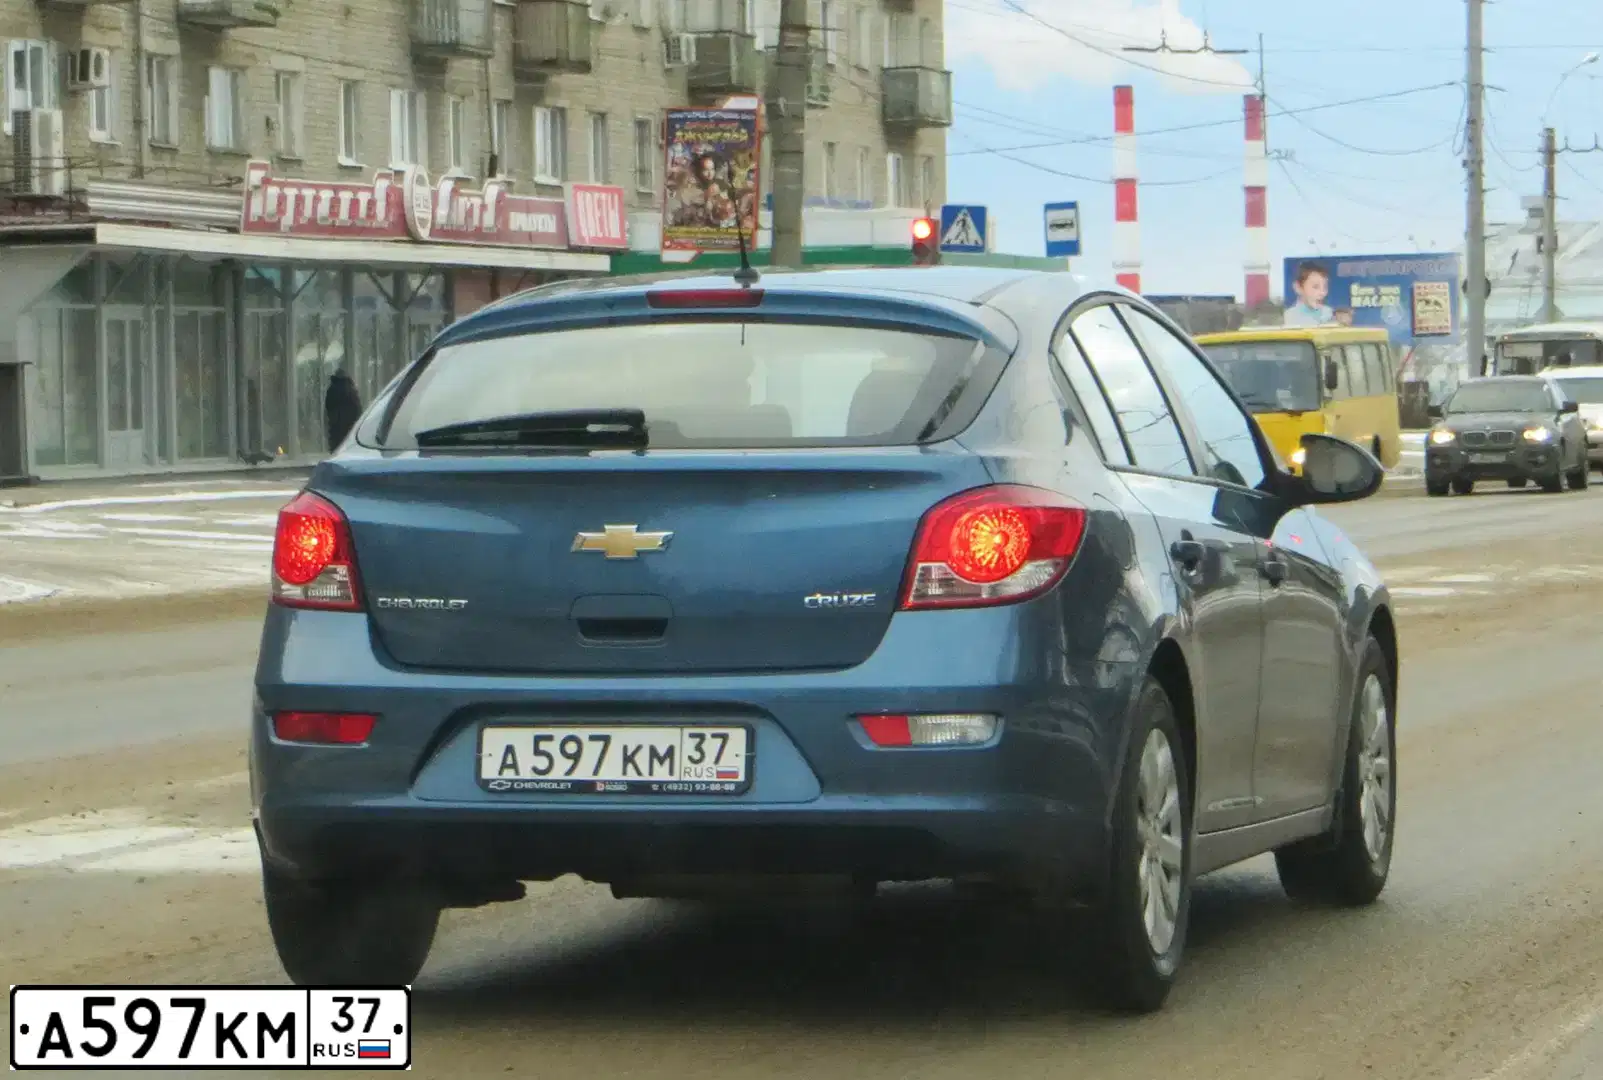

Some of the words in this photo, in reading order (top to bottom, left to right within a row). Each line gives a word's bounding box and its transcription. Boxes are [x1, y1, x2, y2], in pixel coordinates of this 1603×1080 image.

[377, 596, 469, 611] CHEVROLET
[803, 592, 876, 609] CRUZE
[687, 732, 730, 766] 37
[683, 766, 715, 779] RUS
[513, 781, 573, 790] CHEVROLET
